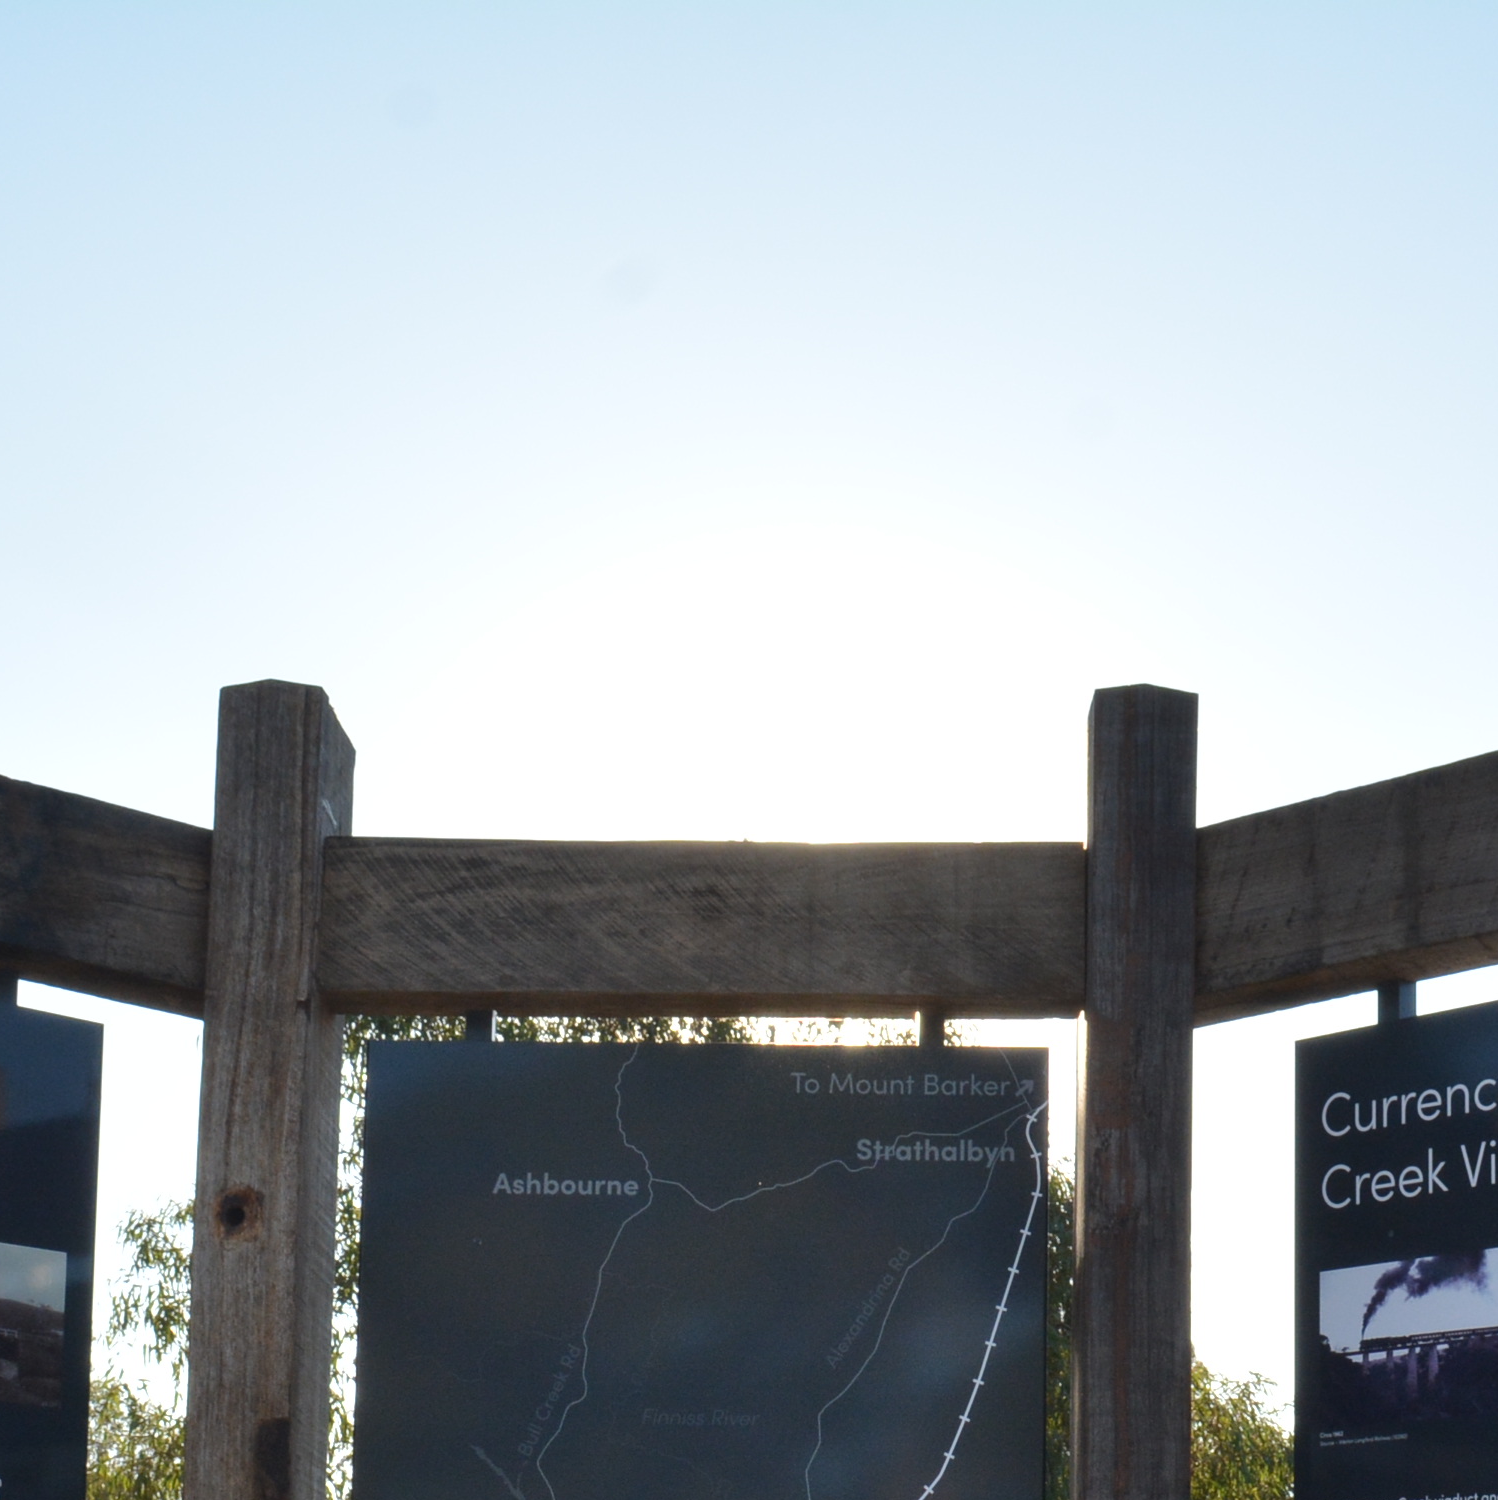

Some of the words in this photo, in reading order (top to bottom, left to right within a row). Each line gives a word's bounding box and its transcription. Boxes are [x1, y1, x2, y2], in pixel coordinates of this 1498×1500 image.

[791, 1072, 820, 1095] To
[829, 1072, 916, 1096] Mount
[924, 1073, 1010, 1097] Barker
[856, 1139, 1016, 1170] Strathalbyn
[492, 1171, 639, 1197] Ashbourne
[1321, 1148, 1449, 1210] Creek
[826, 1273, 894, 1369] Alexandrina
[888, 1246, 911, 1272] Rd
[518, 1423, 543, 1456] Bull
[536, 1372, 569, 1420] Creek
[560, 1343, 580, 1369] Rd
[641, 1408, 704, 1426] Finniss
[711, 1409, 760, 1426] River
